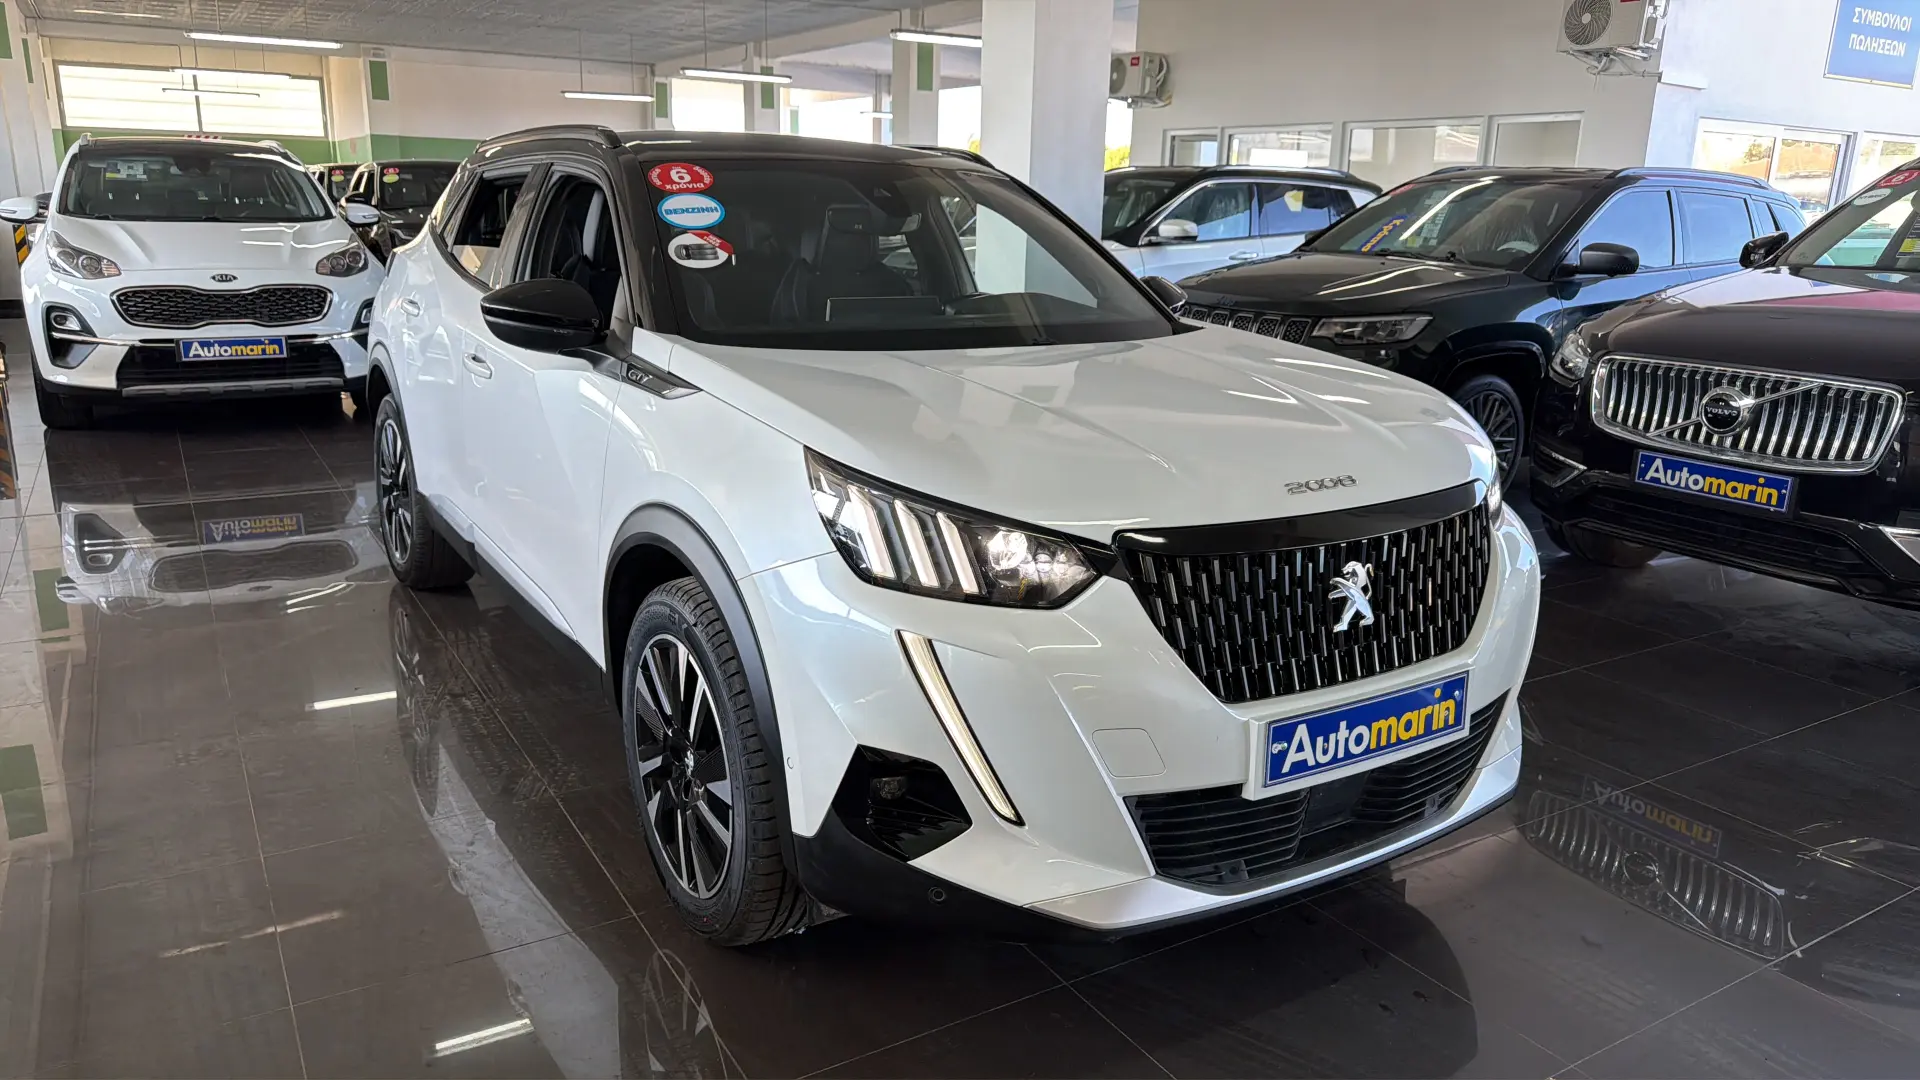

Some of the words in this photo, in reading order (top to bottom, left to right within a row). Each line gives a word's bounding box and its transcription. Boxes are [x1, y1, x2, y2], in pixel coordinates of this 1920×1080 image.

[1852, 7, 1912, 32] ΣΥΜΒΟΥΛΟΙ
[1848, 33, 1906, 57] ΠΩΛΗΣΕΩΝ
[670, 168, 691, 183] 6
[188, 339, 280, 358] Automarin
[1706, 406, 1738, 417] VOLVO
[1284, 474, 1357, 495] 2008
[1645, 457, 1778, 506] Automarin
[1281, 687, 1456, 774] Automarin
